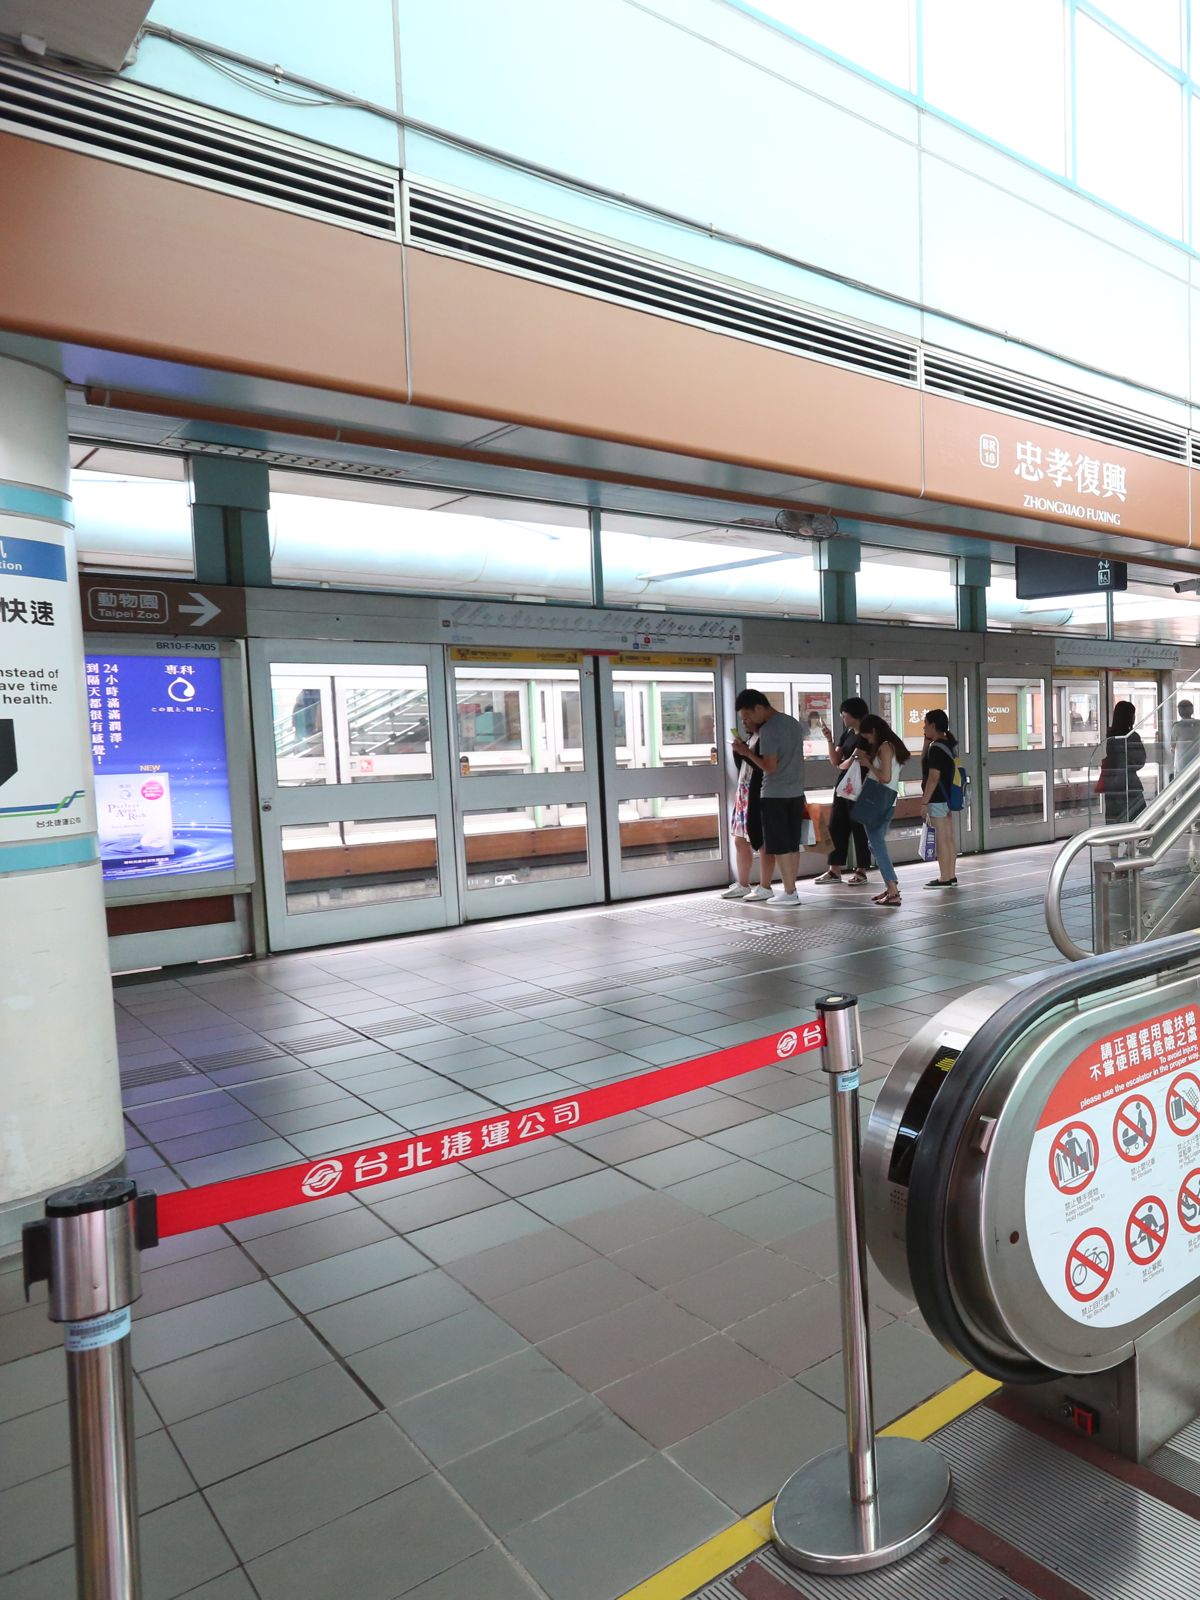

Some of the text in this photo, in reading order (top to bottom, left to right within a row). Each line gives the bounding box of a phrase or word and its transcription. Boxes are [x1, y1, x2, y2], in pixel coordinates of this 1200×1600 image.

[982, 439, 996, 452] BR
[984, 452, 995, 464] 10
[1014, 440, 1127, 502] 忠孝復興
[1023, 494, 1121, 525] ZHONGXIAO FUXING
[97, 592, 159, 609] 動物園
[0, 597, 54, 626] 快速
[98, 608, 160, 619] Taipei Zoo
[156, 642, 217, 651] BR10-F-M05
[48, 669, 59, 678] of
[30, 681, 58, 692] time
[3, 694, 52, 704] health.
[802, 1024, 822, 1047] 台
[1100, 1010, 1196, 1061] 請正確使用電扶梯
[1159, 1044, 1199, 1064] To avoid injury,
[1080, 1052, 1200, 1109] please use the escalator in the proper way.
[353, 1100, 580, 1183] 台北捷運公司
